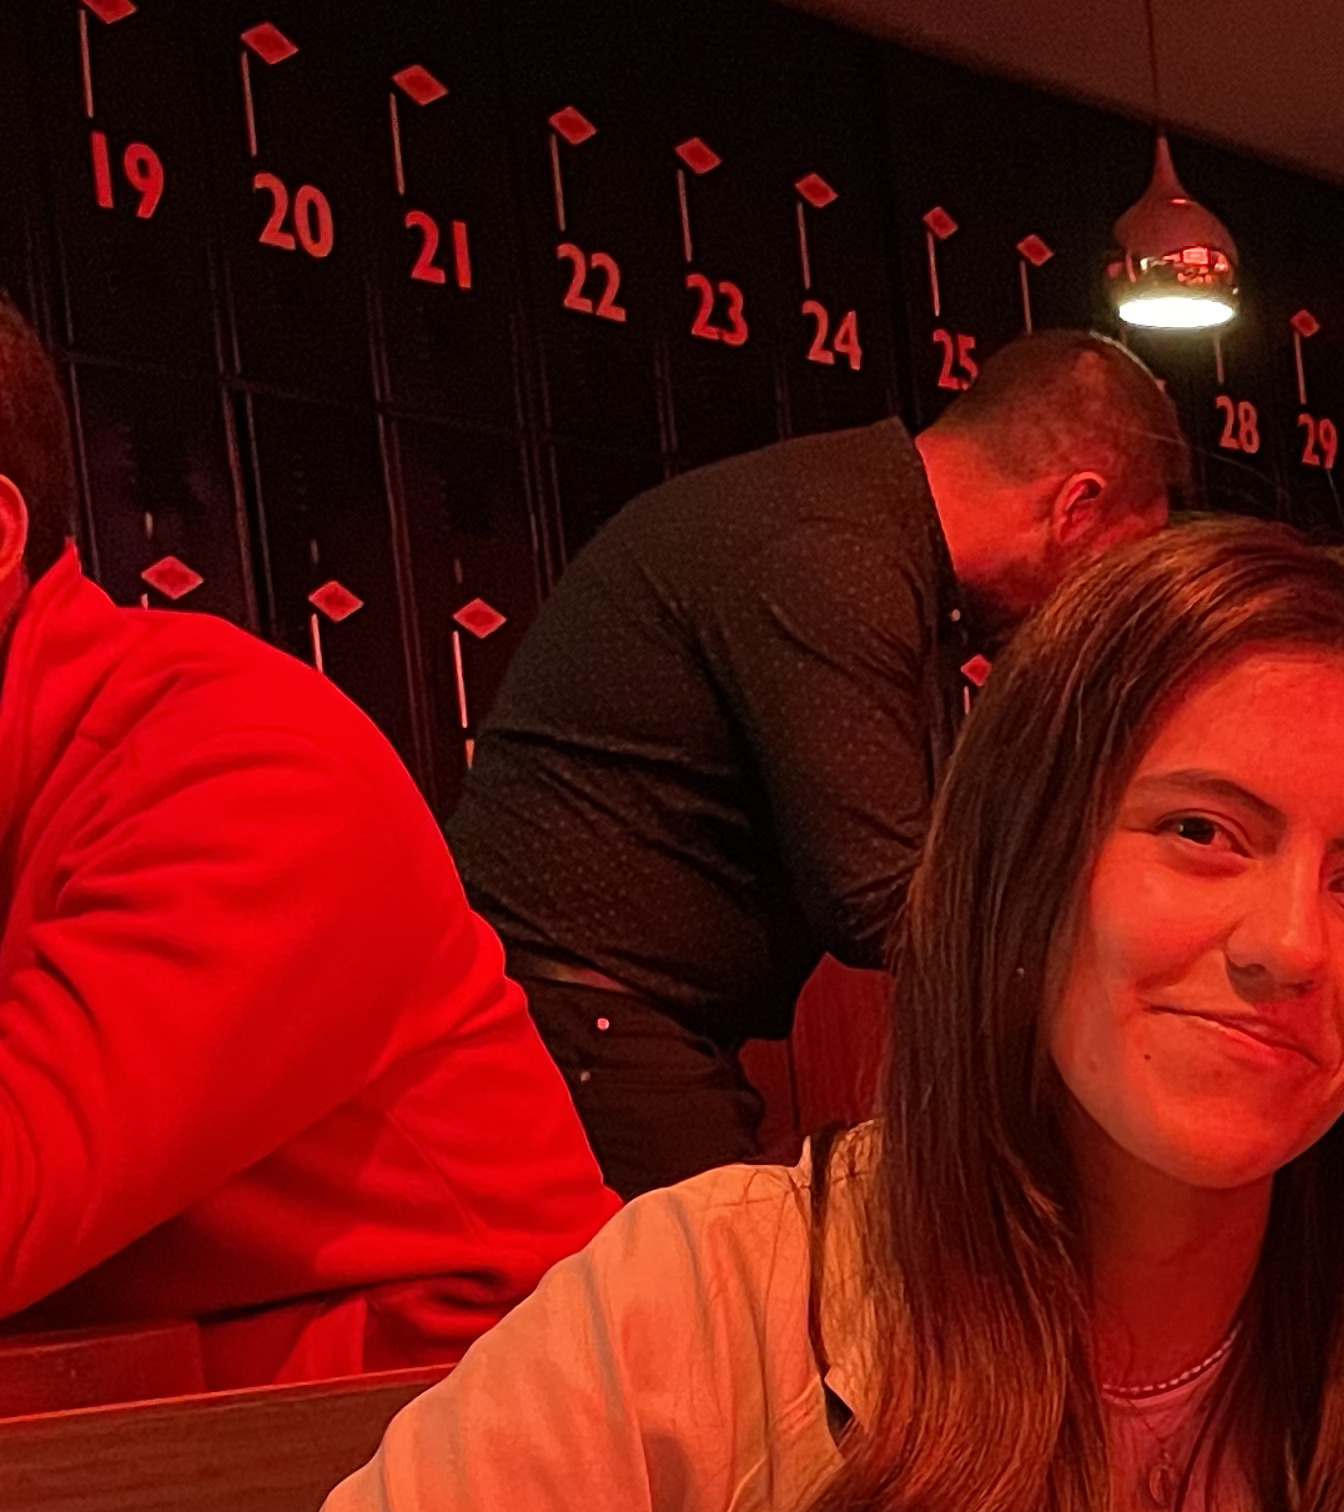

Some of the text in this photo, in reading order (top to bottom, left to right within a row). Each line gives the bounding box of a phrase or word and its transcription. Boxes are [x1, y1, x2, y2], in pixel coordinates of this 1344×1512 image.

[91, 131, 165, 219] 19
[253, 172, 335, 259] 20
[405, 210, 472, 290] 21
[556, 242, 627, 323] 22
[685, 273, 749, 347] 23
[801, 299, 863, 371] 24
[932, 328, 979, 391] 25
[1215, 395, 1261, 454] 28
[1297, 413, 1338, 471] 29
